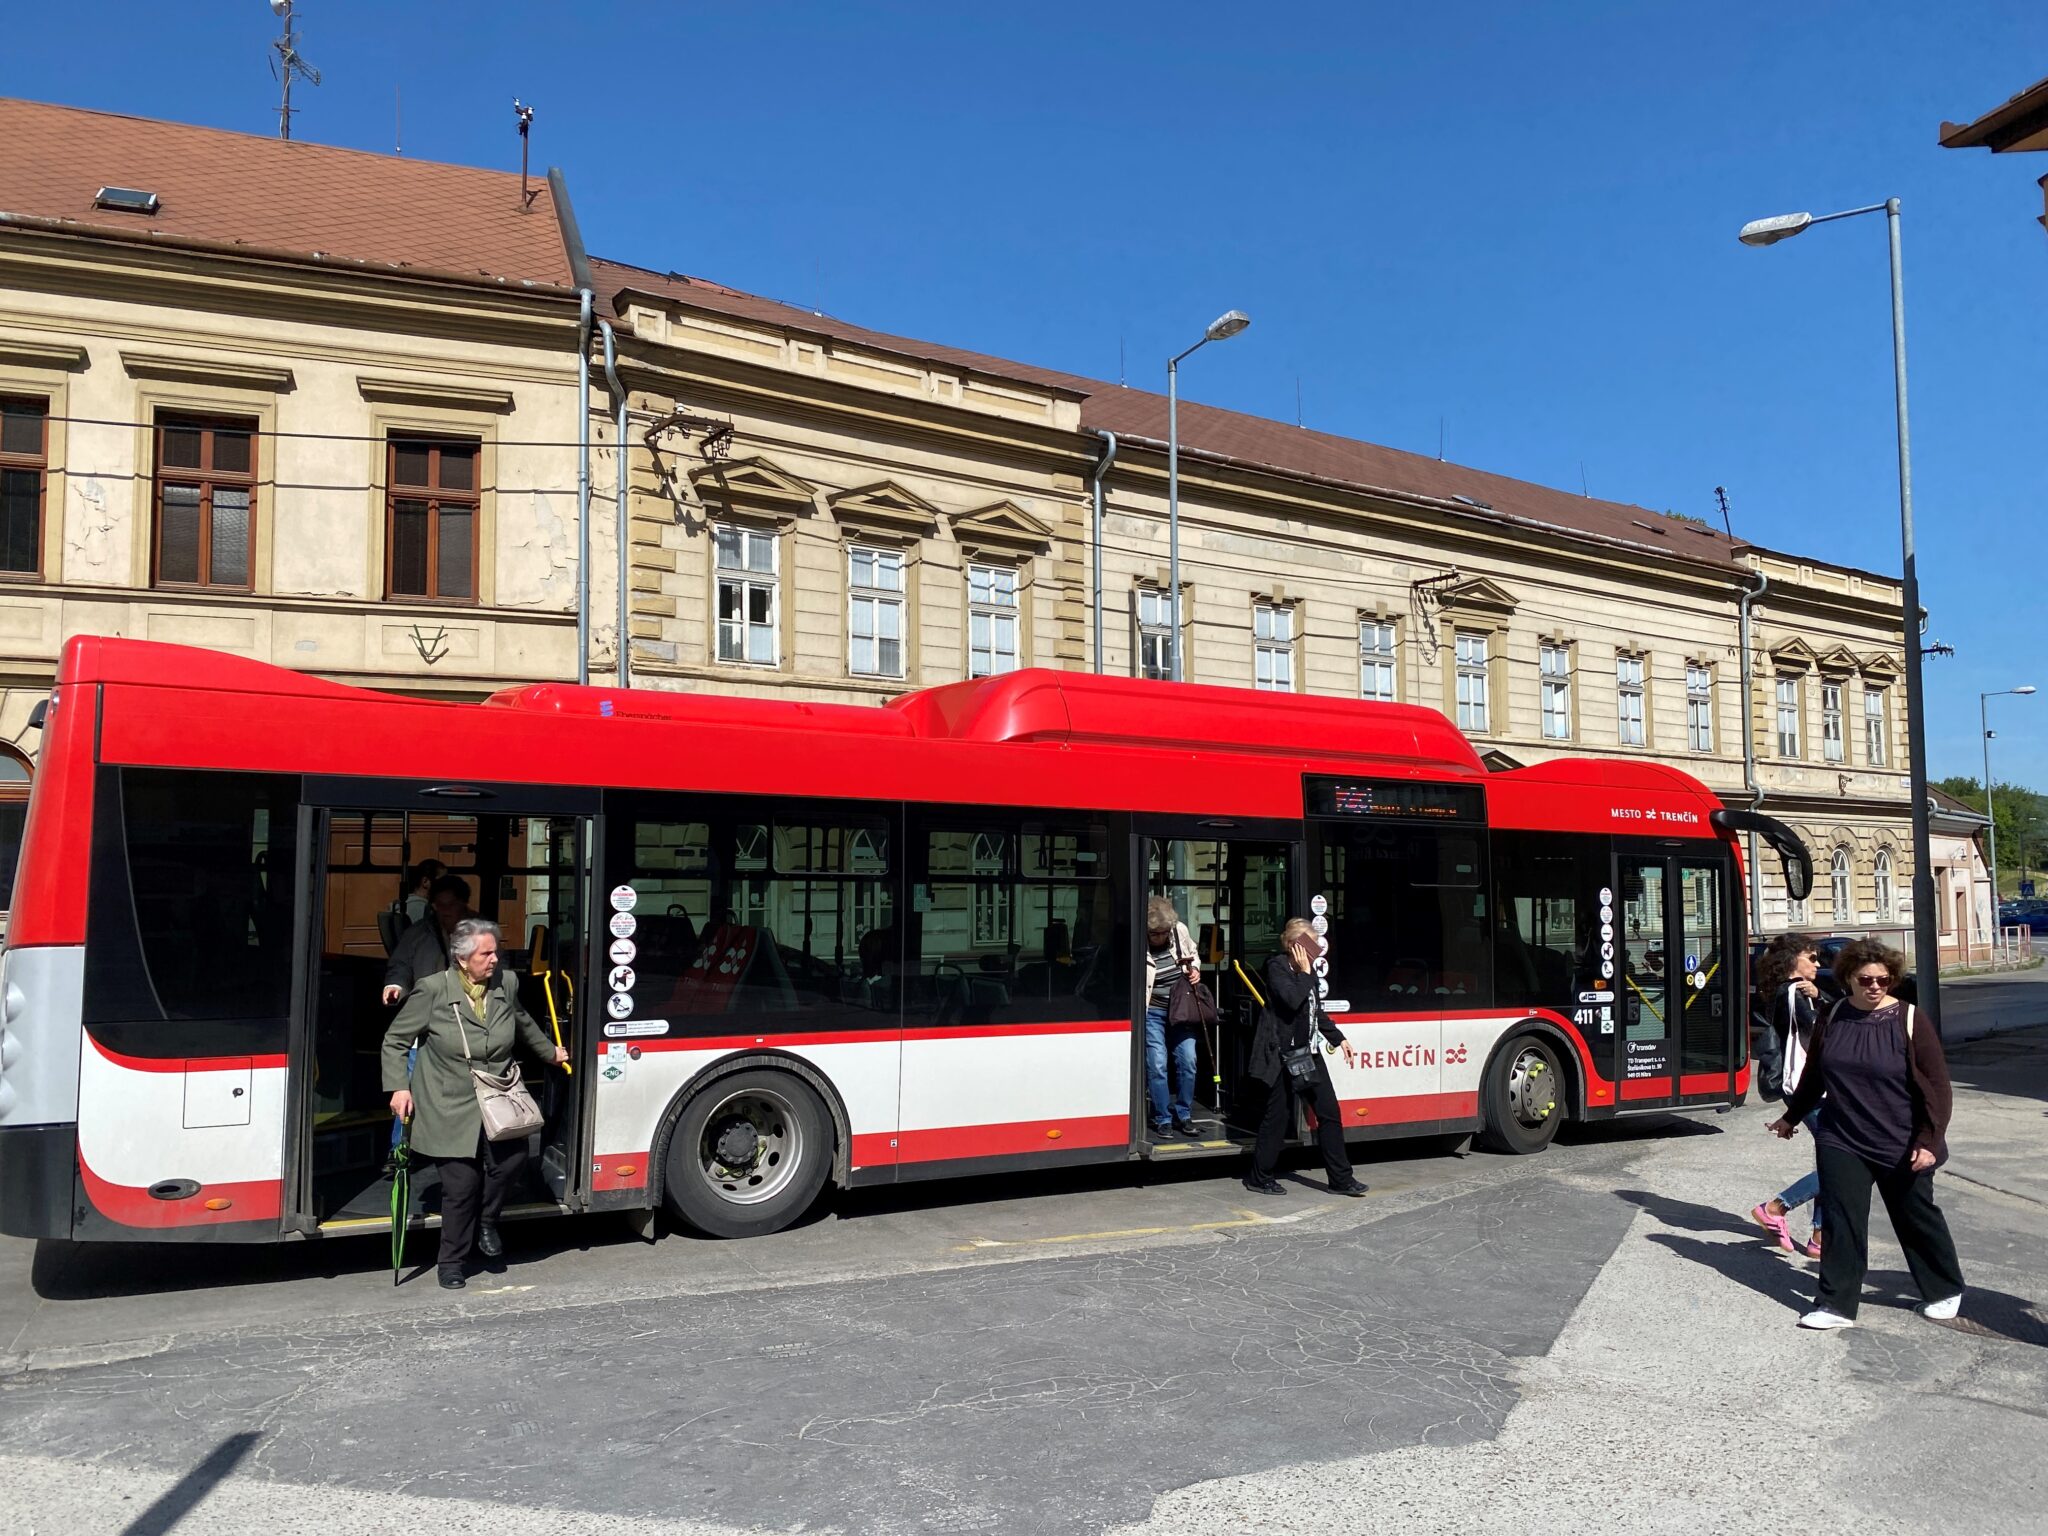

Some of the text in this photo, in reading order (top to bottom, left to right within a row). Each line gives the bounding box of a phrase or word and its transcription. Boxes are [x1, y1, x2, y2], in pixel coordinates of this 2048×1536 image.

[1611, 808, 1698, 823] MESTO TRENČÍN
[1574, 1008, 1593, 1024] 411
